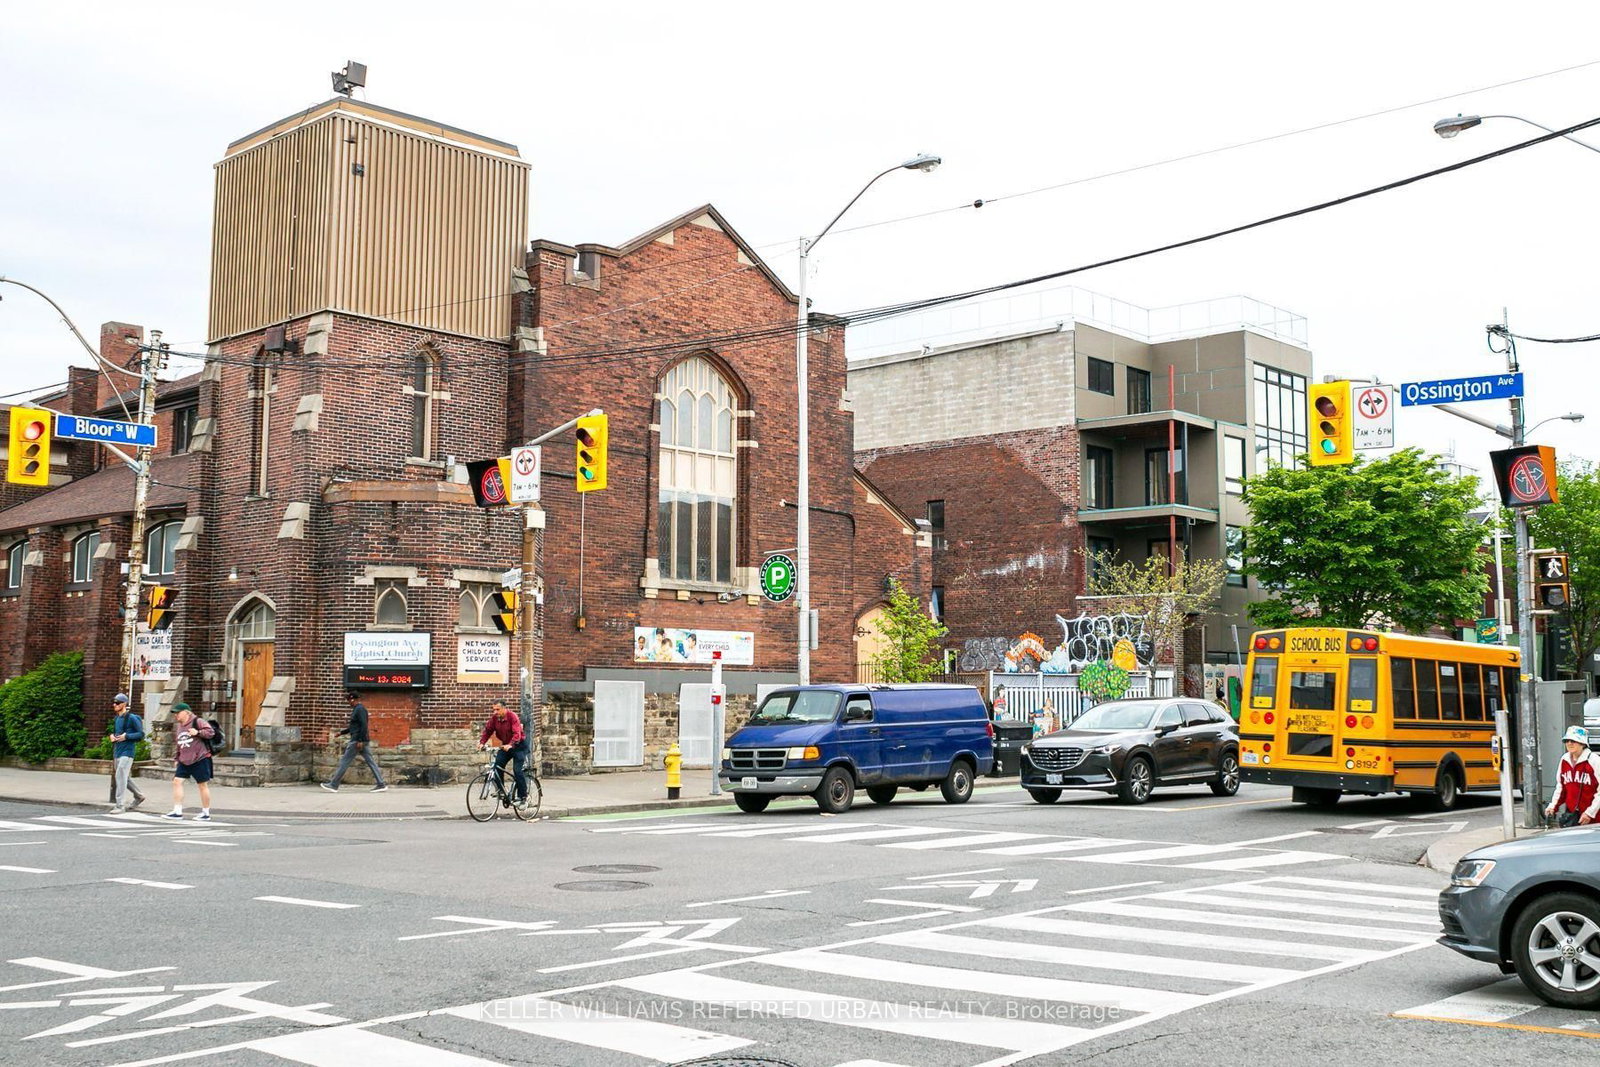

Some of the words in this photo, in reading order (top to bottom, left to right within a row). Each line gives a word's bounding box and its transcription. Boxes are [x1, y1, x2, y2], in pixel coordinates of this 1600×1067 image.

[1406, 380, 1492, 401] Ossington
[1498, 376, 1515, 386] Ave
[75, 418, 115, 437] Bloor
[115, 423, 124, 432] St
[125, 424, 138, 440] W
[761, 556, 796, 577] MUNICIPAL
[771, 567, 786, 586] P
[761, 582, 795, 600] PARKING
[351, 639, 399, 648] Ossington
[698, 643, 714, 651] EVERY
[1291, 637, 1322, 651] SCHOOL
[1324, 638, 1341, 652] BUS
[351, 650, 385, 659] Baptist
[388, 649, 423, 658] Church
[391, 675, 412, 684] 2024
[1356, 760, 1378, 769] 8192
